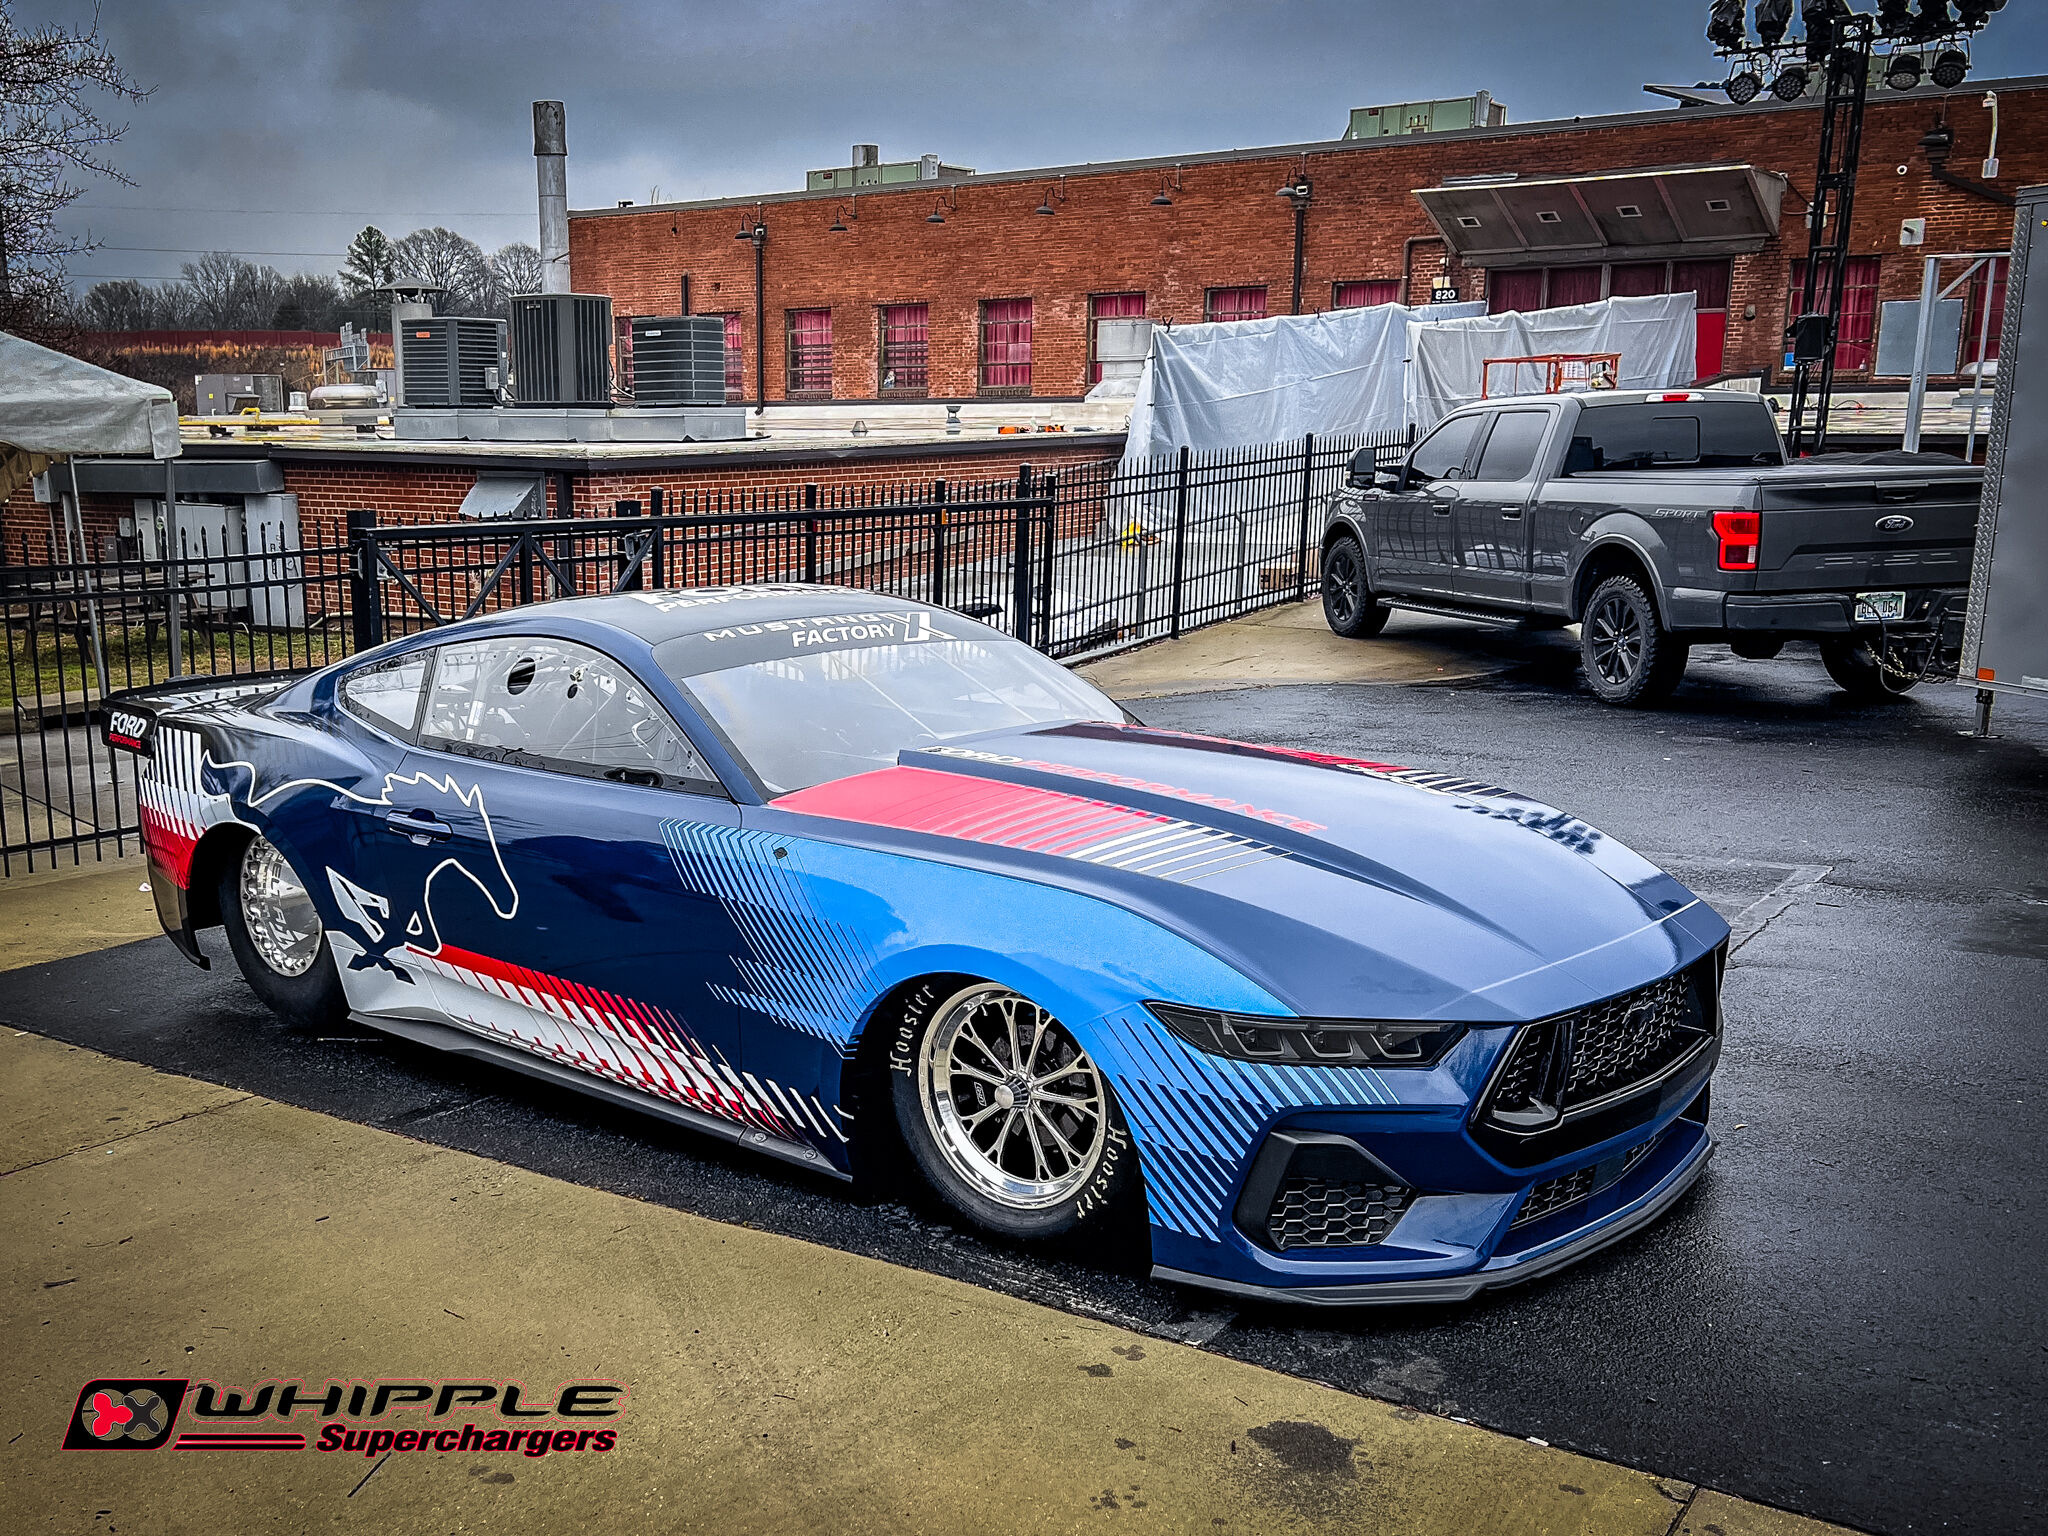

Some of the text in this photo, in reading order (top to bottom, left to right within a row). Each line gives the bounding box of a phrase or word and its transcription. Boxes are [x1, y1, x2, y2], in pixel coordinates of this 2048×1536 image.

[1435, 289, 1456, 300] 820
[1655, 508, 1704, 519] SPORT
[703, 613, 884, 642] MUSTANG
[792, 623, 895, 648] FACTORY
[110, 711, 148, 739] FORD
[917, 745, 1024, 765] FORD
[1013, 759, 1329, 833] PERFORMANCE
[889, 984, 935, 1077] Hoosier
[1076, 1118, 1128, 1219] Hoosier
